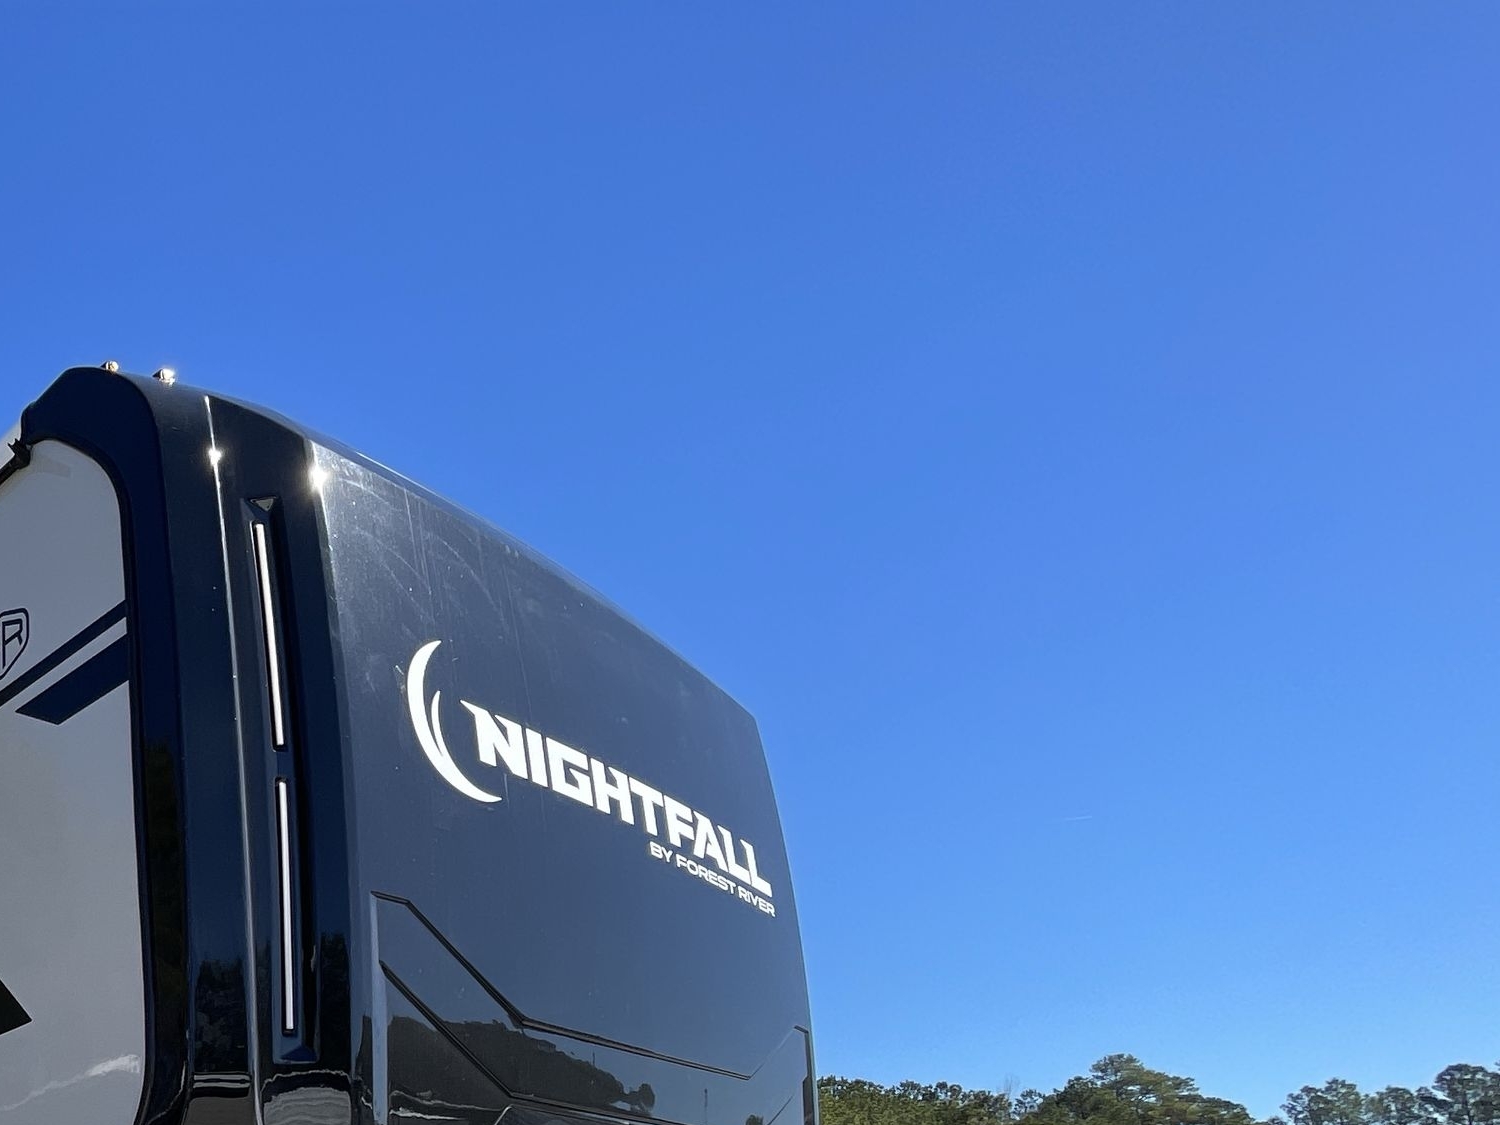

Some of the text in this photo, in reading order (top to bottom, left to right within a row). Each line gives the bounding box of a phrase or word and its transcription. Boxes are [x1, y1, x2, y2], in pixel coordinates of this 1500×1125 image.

[460, 699, 773, 898] NIGHTFALL
[649, 840, 776, 918] BY FOREST RIVER
